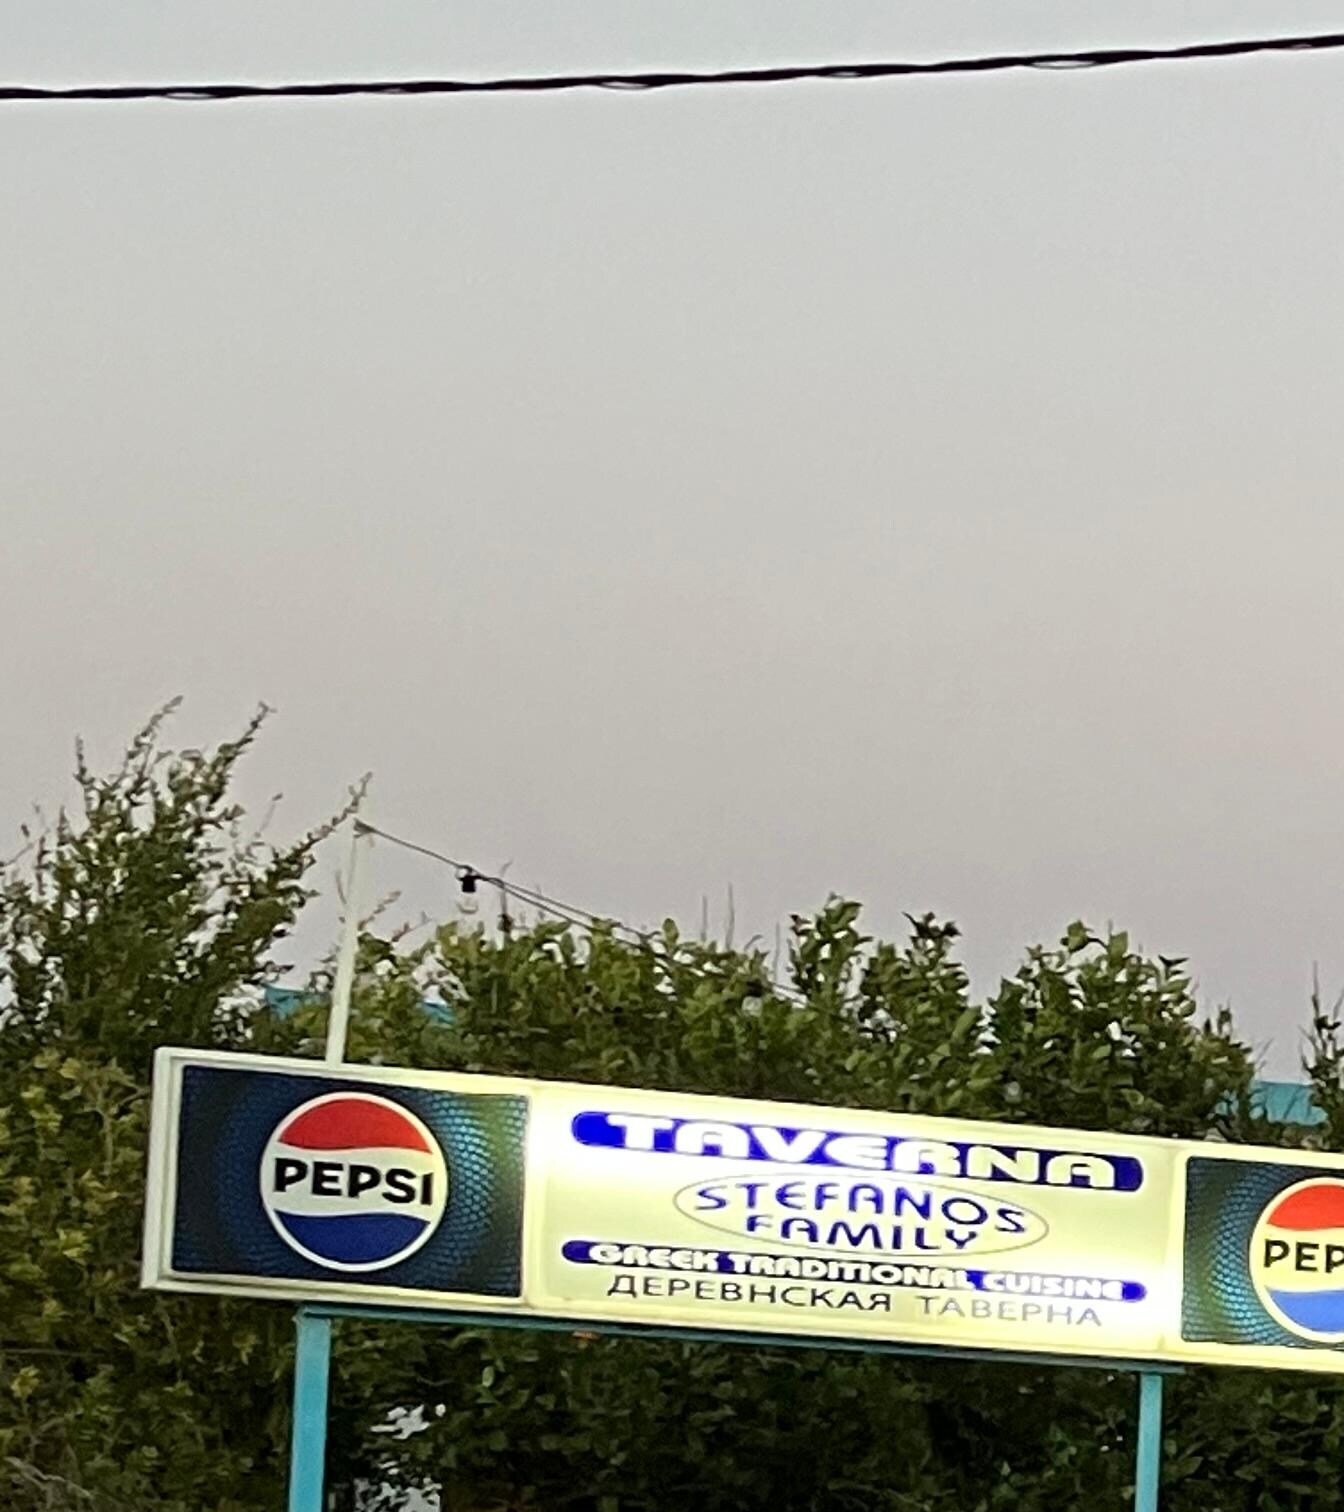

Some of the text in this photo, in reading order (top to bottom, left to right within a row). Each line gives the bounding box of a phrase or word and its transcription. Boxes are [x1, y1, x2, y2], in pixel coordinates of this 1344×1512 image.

[605, 1112, 1116, 1189] TAVERNA
[273, 1157, 434, 1206] PEPSI
[695, 1181, 1027, 1233] STEFANOS
[746, 1214, 978, 1250] FAMILY
[588, 1244, 1124, 1300] GREEK TRADITIONAL CUISINE
[607, 1274, 1102, 1326] ДЕРЕВНСКАЯ ТАВЕРНА
